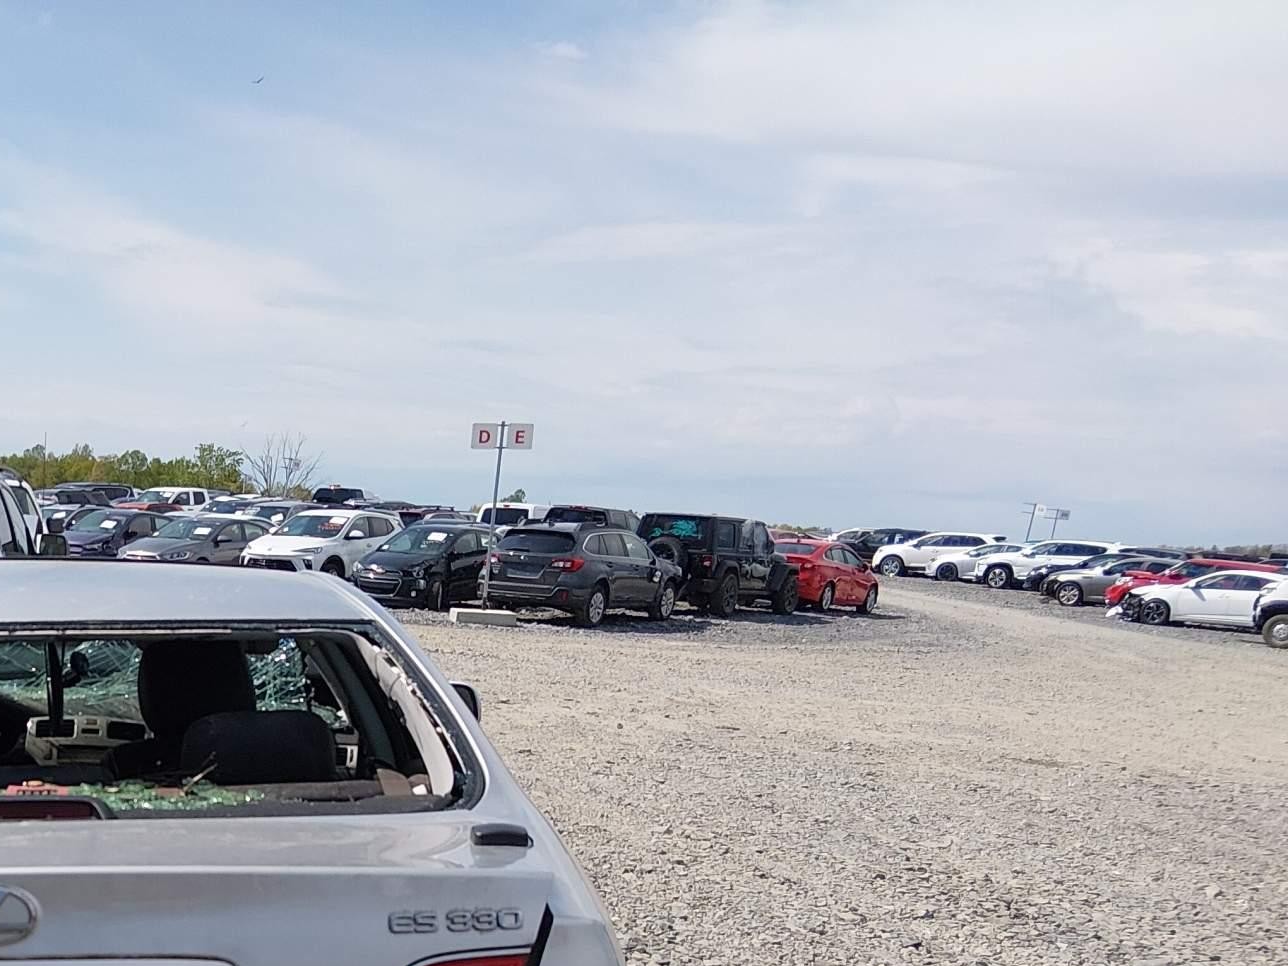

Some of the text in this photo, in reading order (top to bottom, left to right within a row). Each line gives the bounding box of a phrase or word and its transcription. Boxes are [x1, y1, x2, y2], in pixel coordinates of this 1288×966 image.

[479, 430, 490, 443] D
[515, 430, 525, 443] E
[388, 909, 523, 934] ES 330
